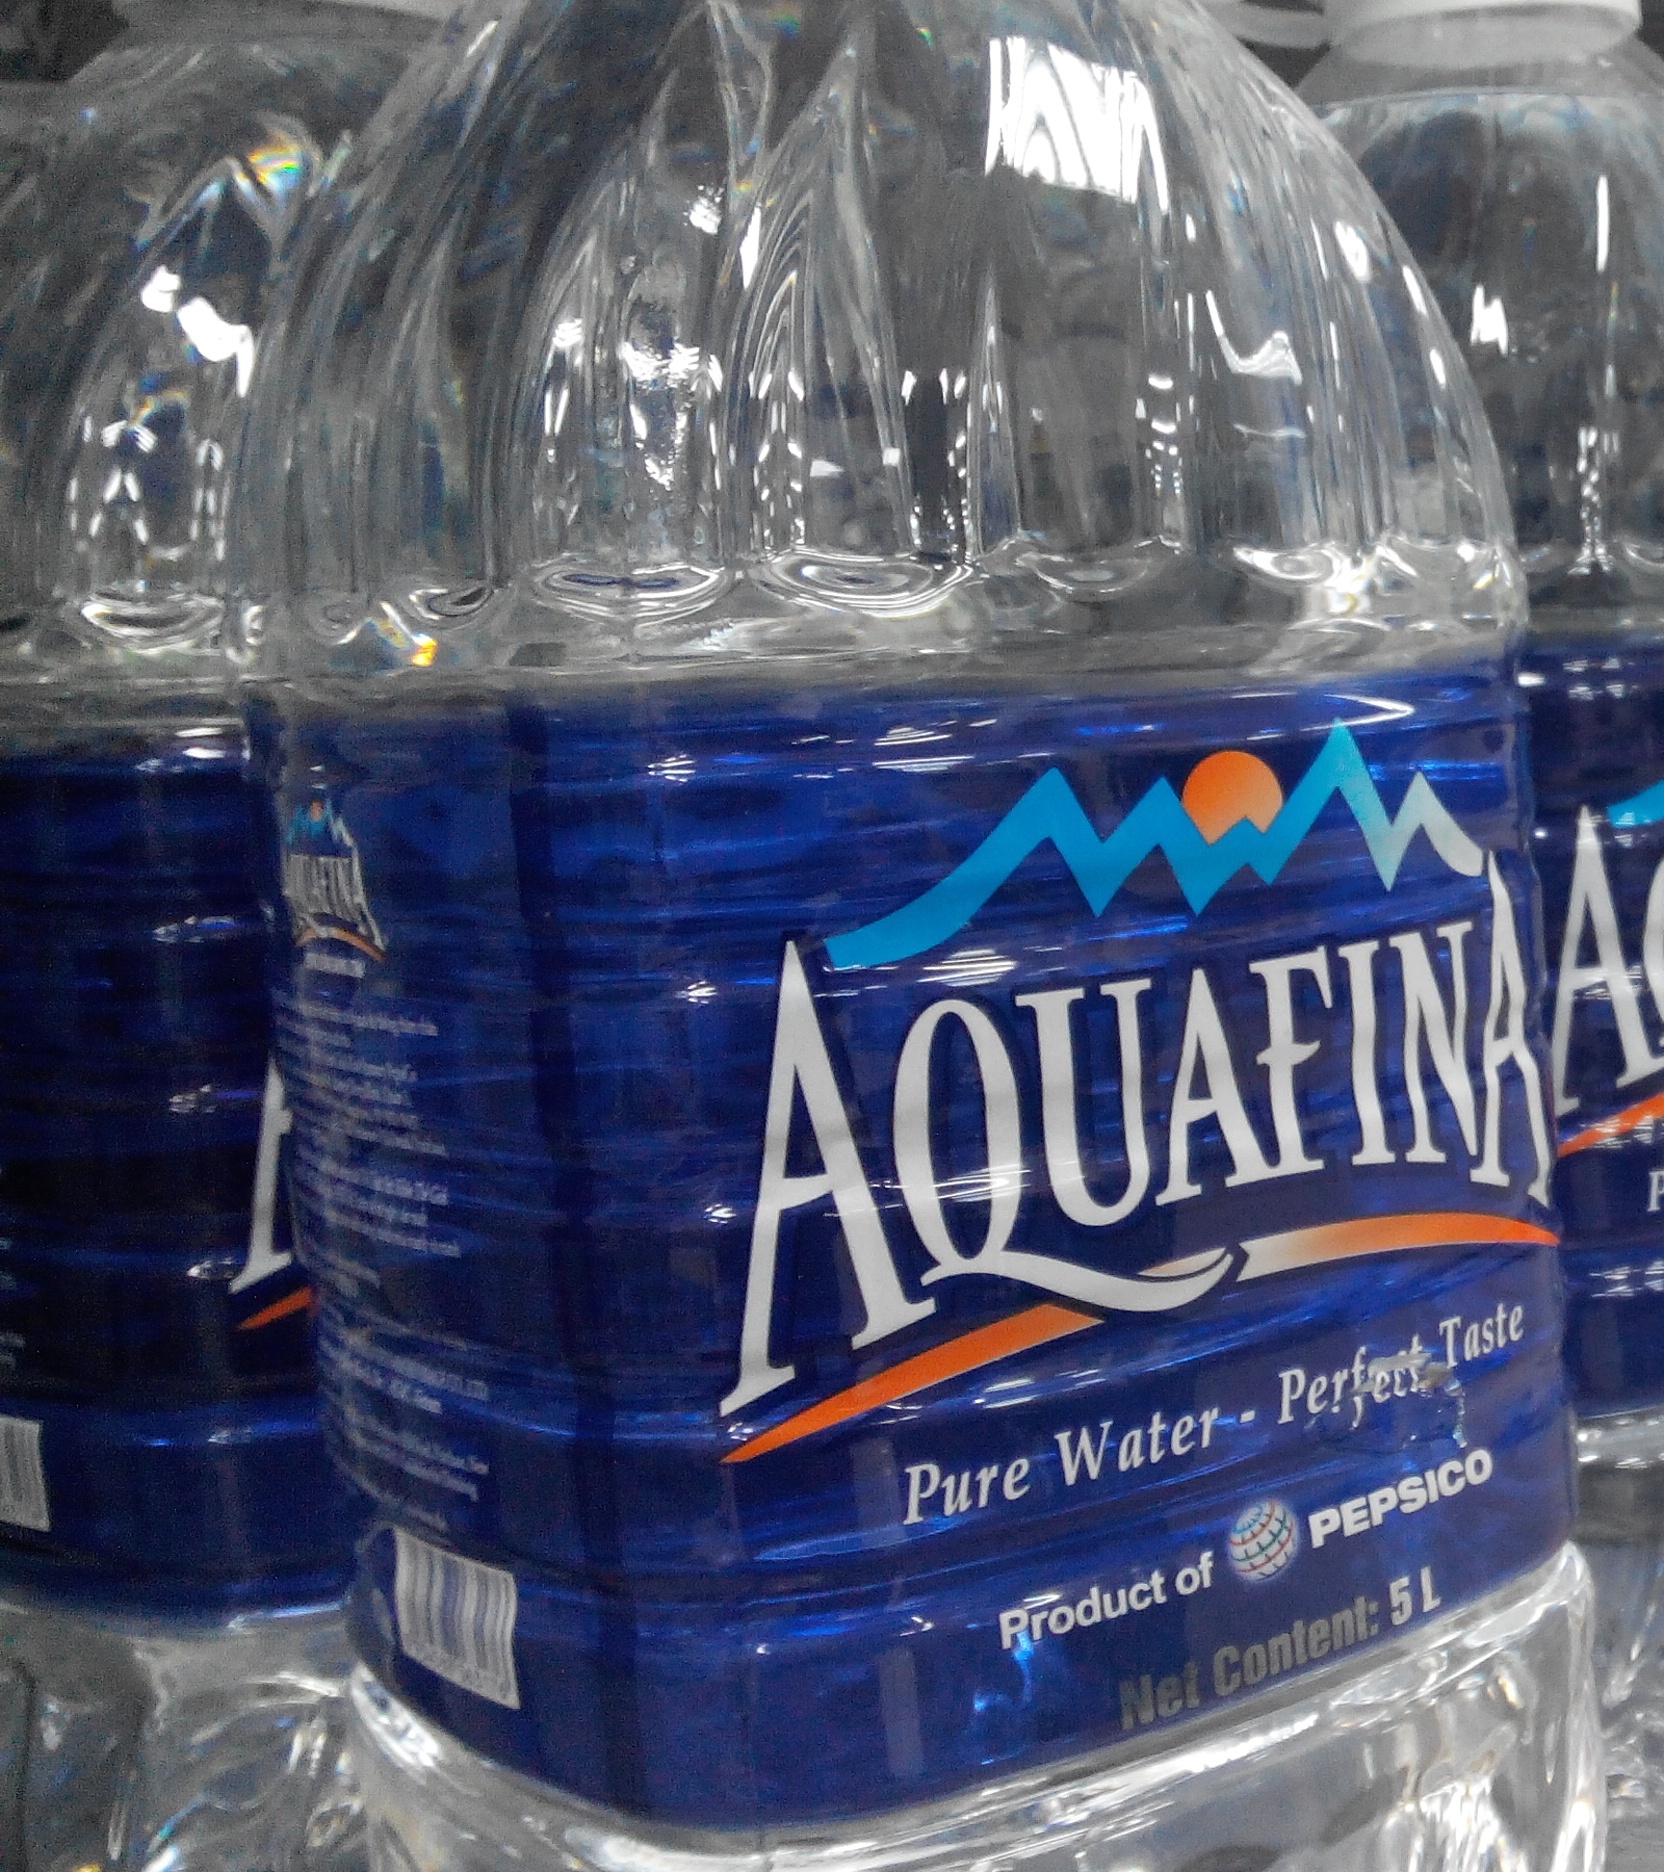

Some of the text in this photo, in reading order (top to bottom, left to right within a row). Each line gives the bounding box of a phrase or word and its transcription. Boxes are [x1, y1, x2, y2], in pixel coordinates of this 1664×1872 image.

[720, 851, 1550, 1416] AQUAFINA
[903, 1455, 1031, 1526] Pure
[1055, 1406, 1221, 1487] Water
[1277, 1333, 1425, 1429] Perfect
[1438, 1302, 1525, 1369] Taste
[999, 1447, 1495, 1650] Product of PEPSICO
[1119, 1663, 1200, 1732] Net
[1212, 1598, 1381, 1699] Content:
